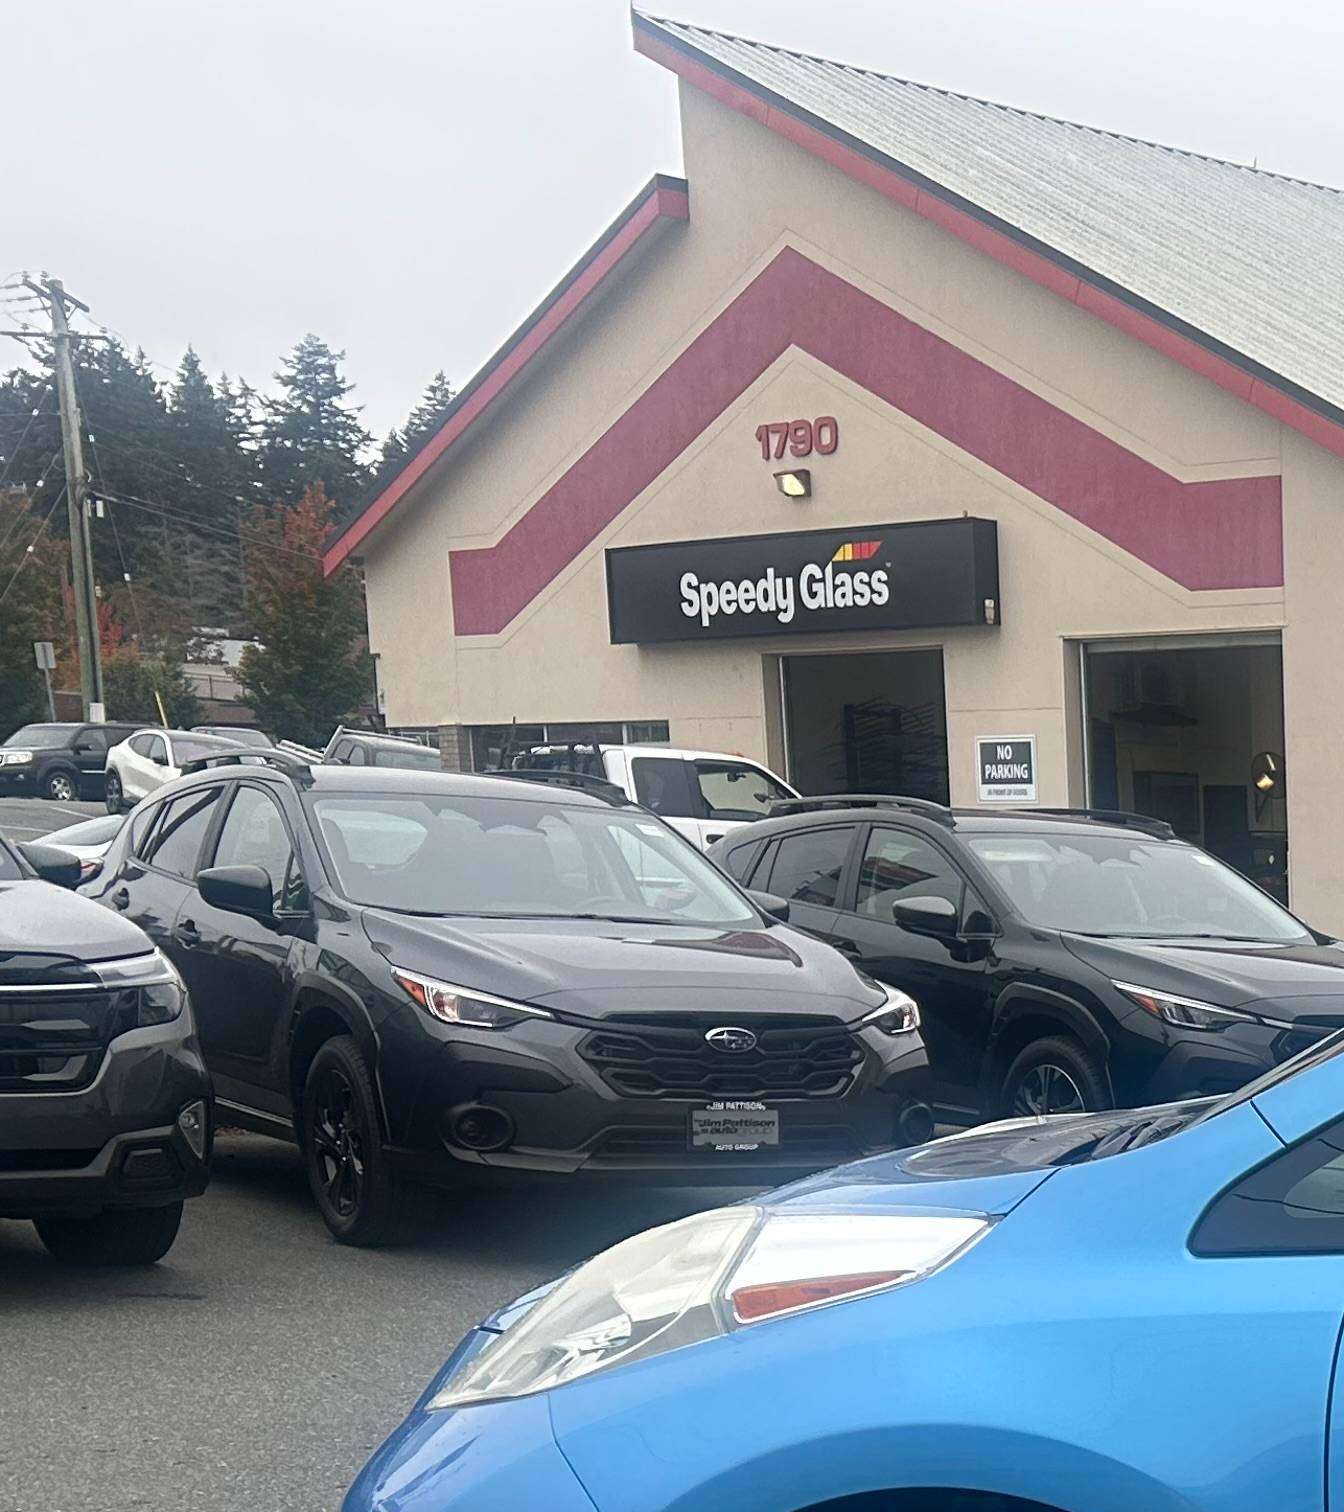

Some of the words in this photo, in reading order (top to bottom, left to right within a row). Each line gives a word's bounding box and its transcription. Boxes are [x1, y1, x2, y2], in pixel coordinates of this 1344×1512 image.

[755, 416, 839, 461] 1790
[680, 567, 795, 627] Speedy
[800, 560, 890, 610] Glass
[996, 744, 1012, 760] NO
[984, 763, 1028, 779] PARKING
